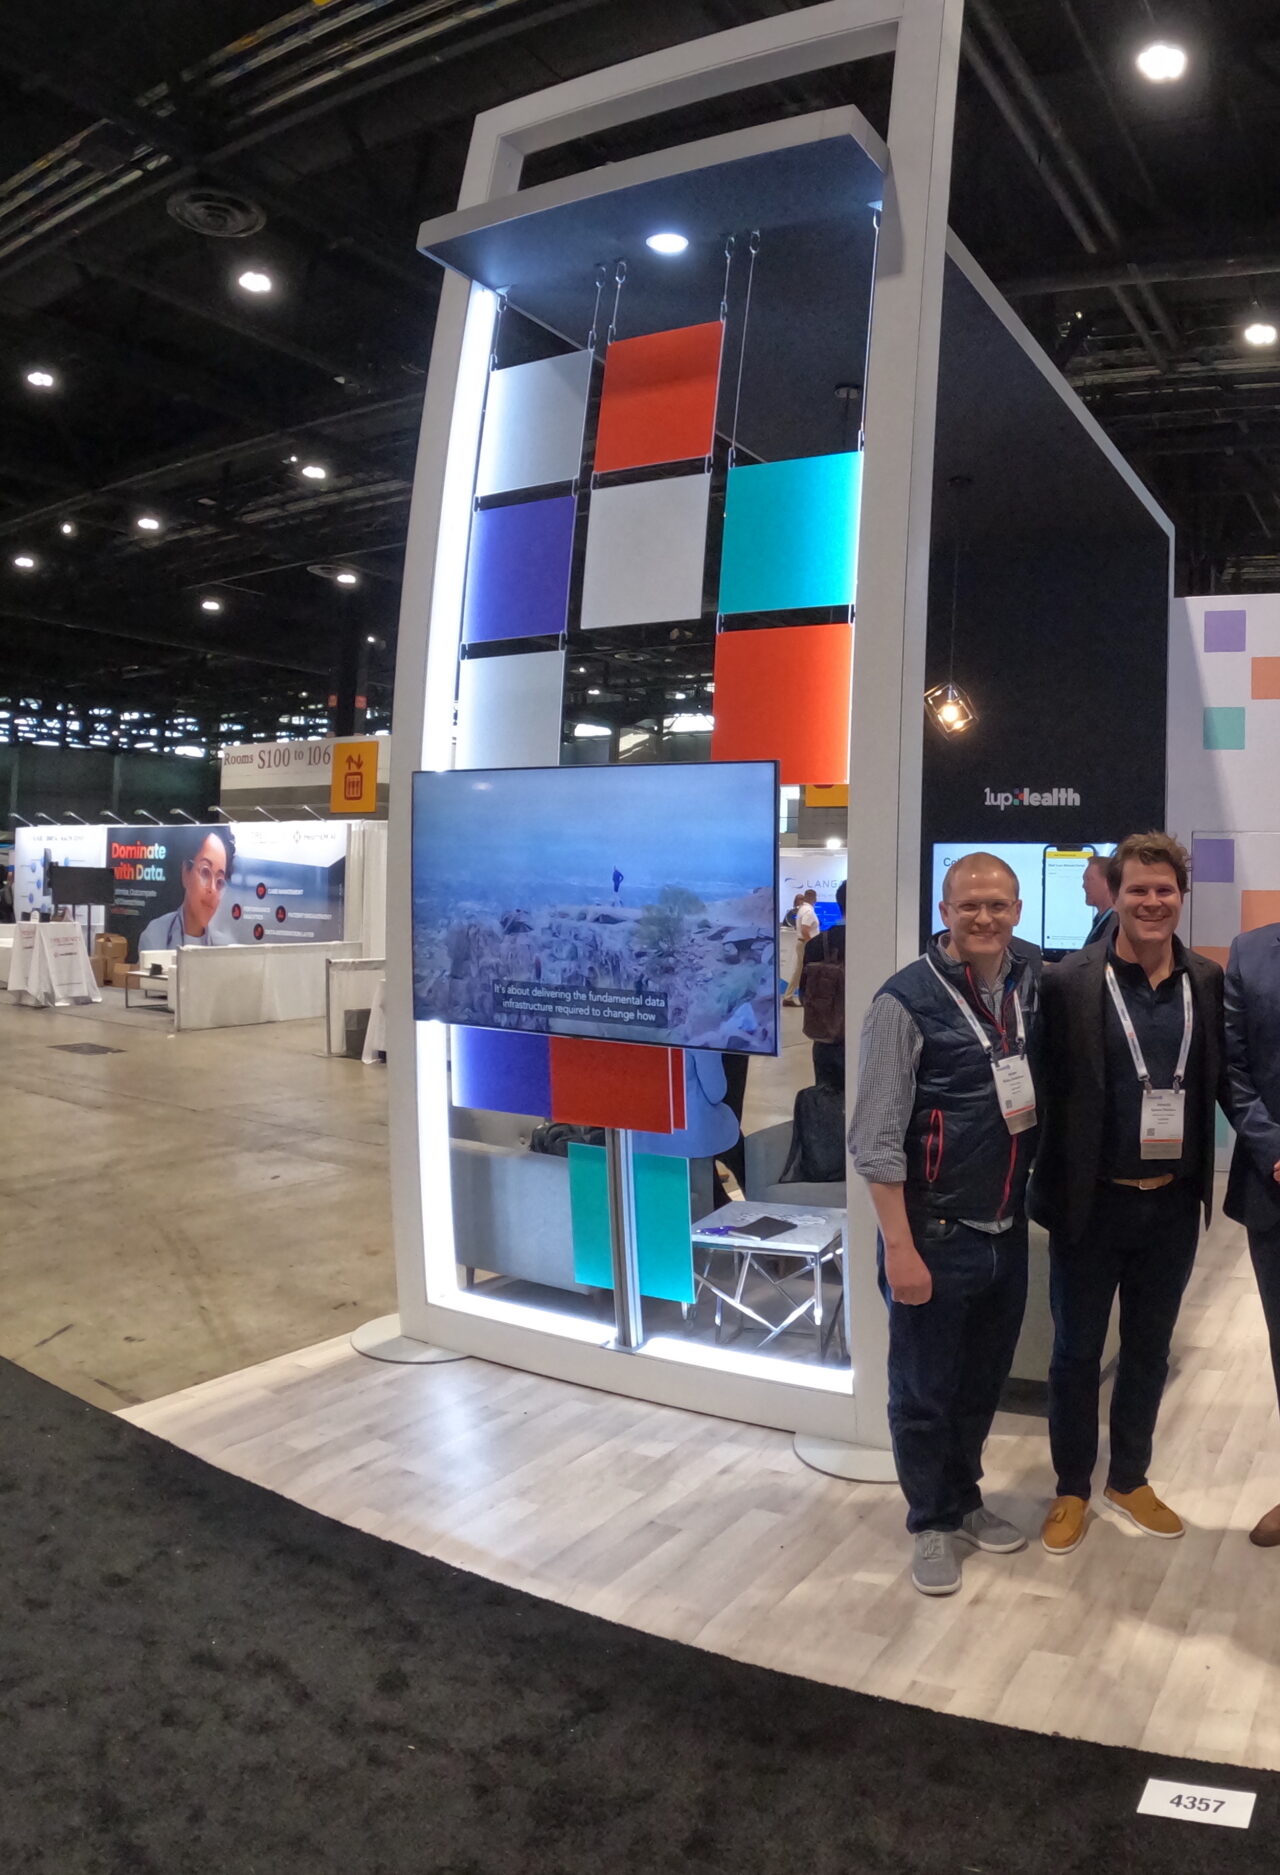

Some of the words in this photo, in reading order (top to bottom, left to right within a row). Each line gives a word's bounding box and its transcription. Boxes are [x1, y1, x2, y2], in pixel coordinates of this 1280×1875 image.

[224, 753, 253, 765] Rooms
[258, 748, 291, 769] S100
[294, 750, 304, 760] to
[307, 745, 331, 766] 106
[111, 840, 166, 859] Dominate
[136, 864, 166, 881] Data.
[507, 986, 530, 996] about
[532, 987, 571, 1002] delivering
[573, 991, 587, 1000] the
[588, 991, 643, 1006] fundamental
[645, 996, 665, 1007] data
[503, 999, 553, 1012] infrastructure
[555, 1006, 590, 1017] required
[592, 1008, 600, 1016] to
[603, 1008, 634, 1022] change
[637, 1011, 656, 1022] how
[1169, 1794, 1226, 1813] 4357
